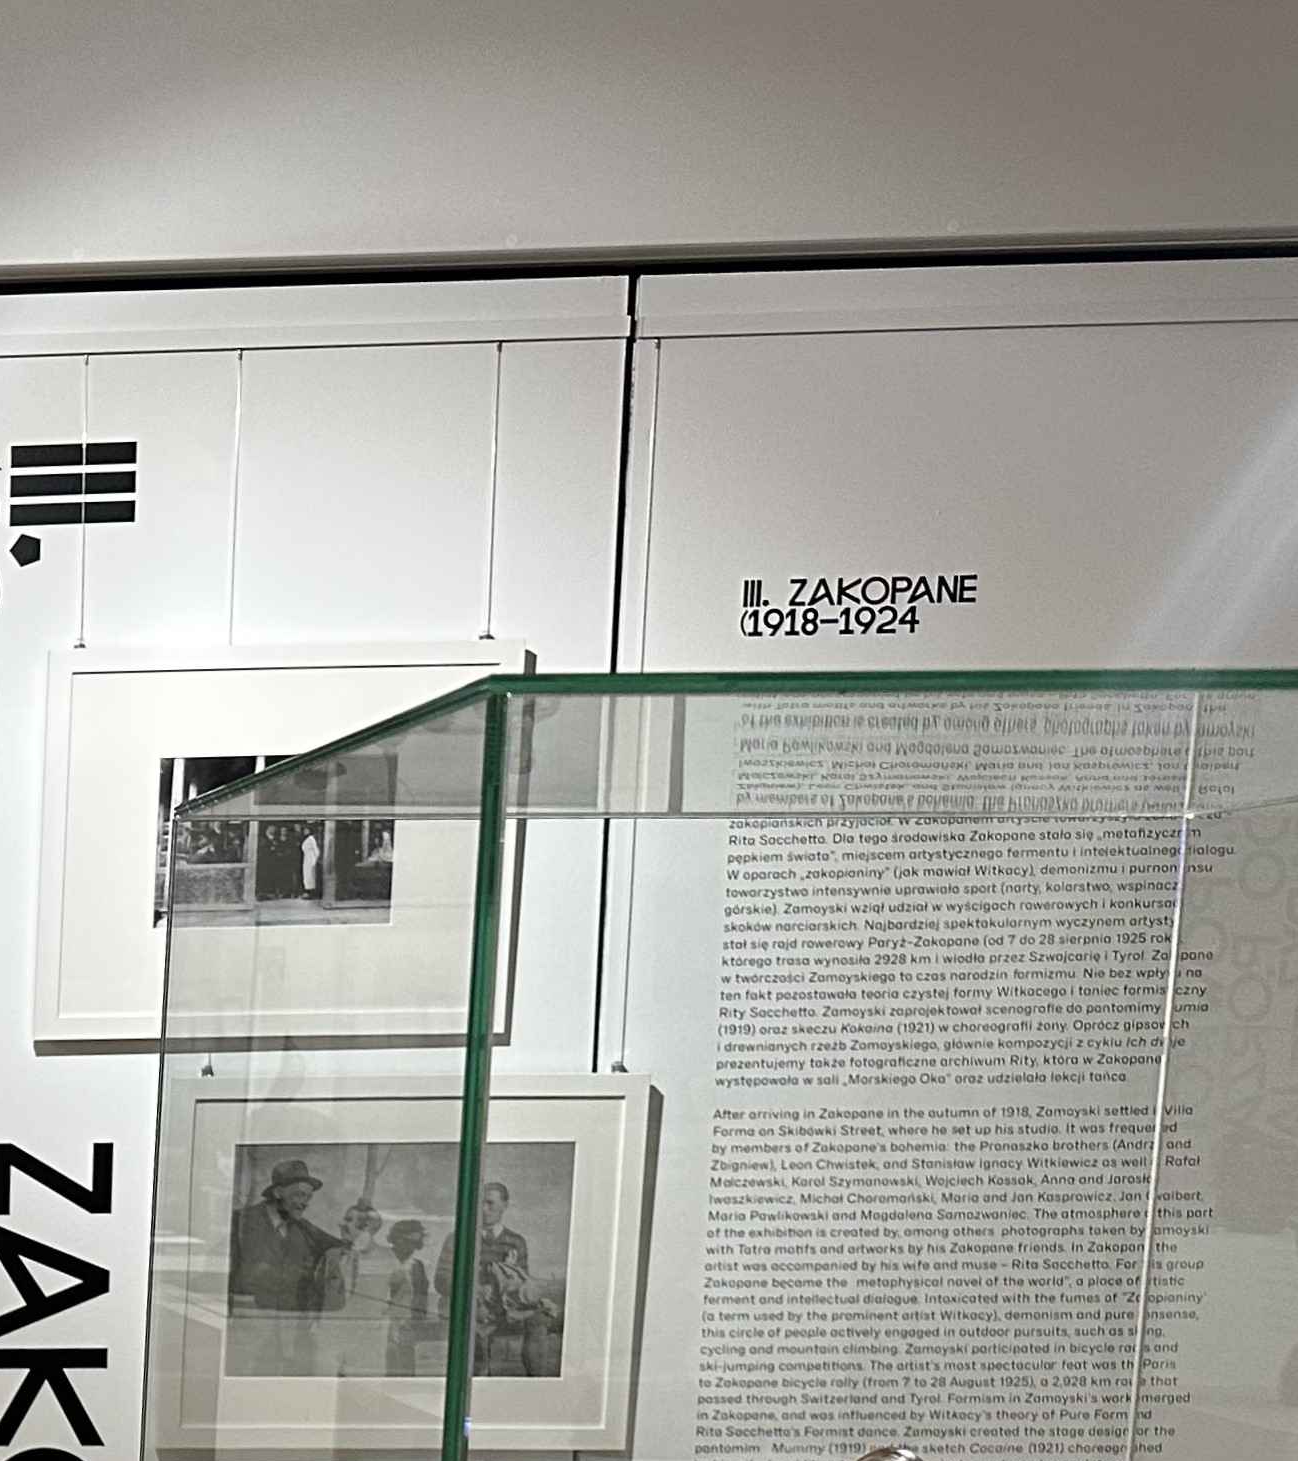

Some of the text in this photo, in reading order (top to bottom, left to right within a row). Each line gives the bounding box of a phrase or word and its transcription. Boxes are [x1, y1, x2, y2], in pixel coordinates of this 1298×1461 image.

[9, 441, 137, 567] III.
[742, 574, 978, 609] III. ZAKOPANE
[728, 834, 755, 846] Rita
[832, 832, 854, 844] Dla
[858, 833, 888, 846] tego
[968, 829, 1035, 843] Zakopane
[864, 918, 939, 933] Najbardziej
[943, 916, 1052, 931] spektakularnym
[1055, 917, 1125, 929] wyczynem
[771, 937, 797, 951] rajd
[801, 938, 864, 951] rowerowy
[1007, 933, 1016, 945] 7
[1018, 934, 1035, 945] do
[1038, 933, 1055, 945] 28
[1058, 932, 1111, 946] sierpnia
[1116, 931, 1146, 944] 1925
[717, 1023, 756, 1037] (1919)
[758, 1025, 787, 1035] oraz
[896, 1020, 935, 1035] (1921)
[938, 1024, 949, 1032] w
[1072, 1018, 1119, 1032] Oprócz
[715, 1057, 805, 1071] prezentujemy
[1082, 1056, 1093, 1064] w
[712, 1108, 745, 1120] After
[747, 1109, 799, 1122] arriving
[802, 1108, 815, 1119] in
[818, 1106, 884, 1120] Zakopane
[886, 1108, 899, 1118] in
[903, 1107, 925, 1118] the
[927, 1107, 979, 1118] autumn
[982, 1106, 997, 1118] of
[1035, 1105, 1100, 1119] Zamoyski
[1103, 1104, 1148, 1116] settled
[707, 1209, 746, 1221] Maria
[749, 1209, 829, 1222] Pawlikowski
[831, 1210, 857, 1221] and
[860, 1208, 932, 1222] Magdalena
[1033, 1207, 1057, 1219] The
[1060, 1206, 1140, 1221] atmosphere
[705, 1244, 734, 1255] with
[737, 1243, 771, 1255] Tatra
[819, 1243, 844, 1254] and
[847, 1243, 904, 1255] artworks
[907, 1243, 923, 1256] by
[926, 1242, 946, 1254] his
[949, 1241, 1014, 1255] Zakopane
[1071, 1241, 1083, 1252] In
[869, 1359, 893, 1371] The
[943, 1360, 976, 1371] most
[980, 1358, 1057, 1372] spectacular
[1061, 1358, 1088, 1370] feat
[1091, 1360, 1116, 1370] was
[697, 1393, 742, 1405] passed
[745, 1393, 797, 1406] through
[800, 1392, 877, 1404] Switzerland
[880, 1393, 905, 1404] and
[947, 1392, 1005, 1404] Formism
[1008, 1392, 1020, 1403] in
